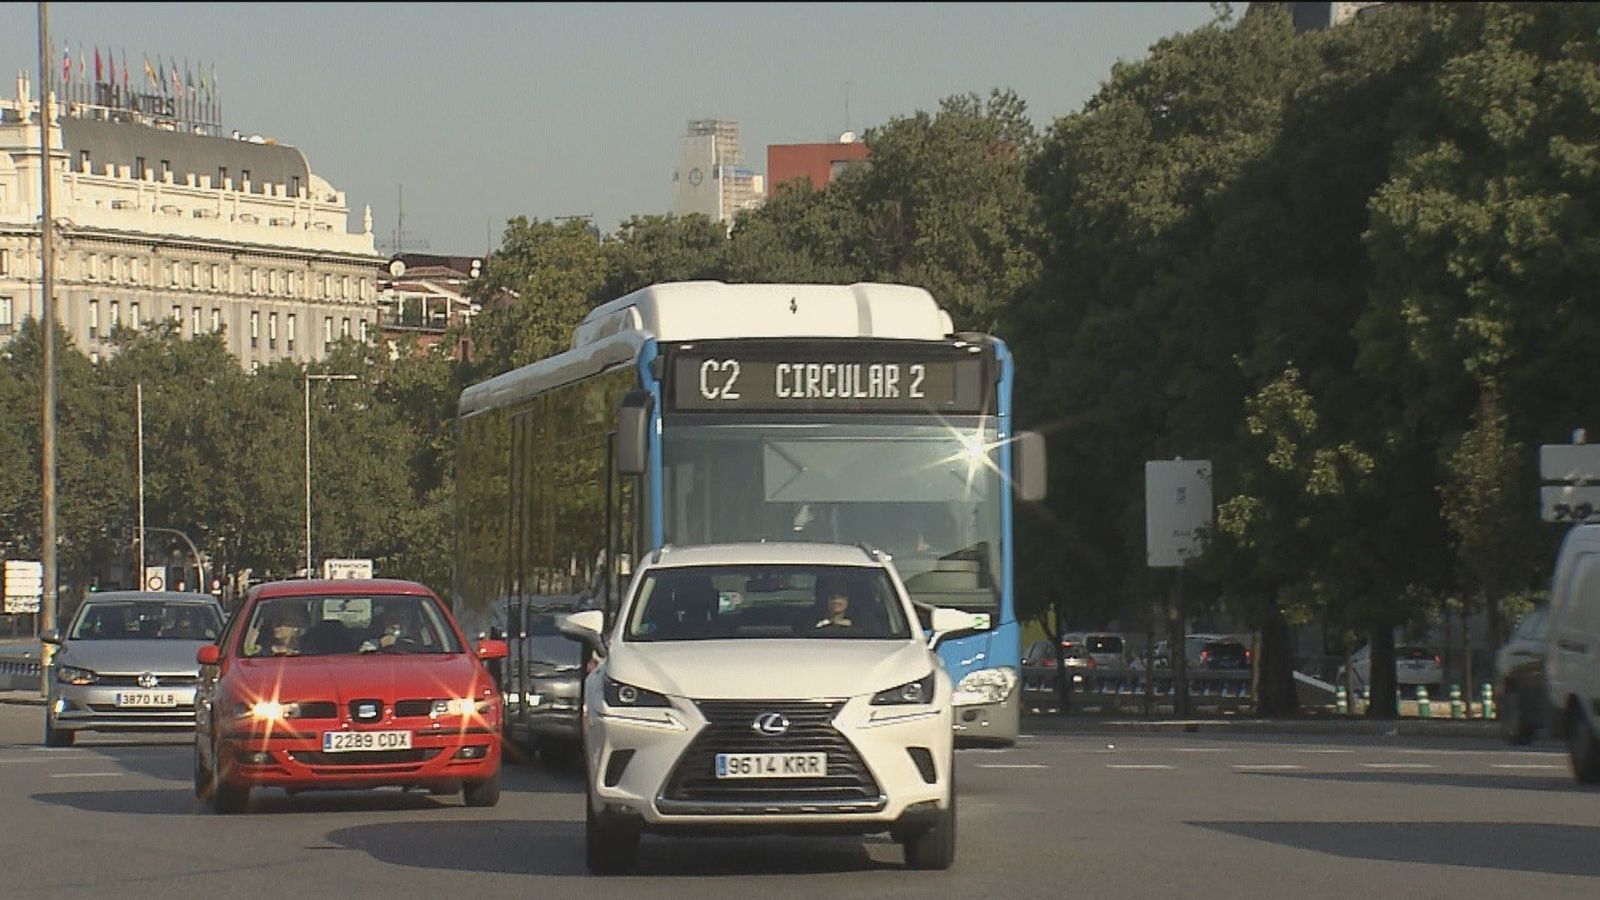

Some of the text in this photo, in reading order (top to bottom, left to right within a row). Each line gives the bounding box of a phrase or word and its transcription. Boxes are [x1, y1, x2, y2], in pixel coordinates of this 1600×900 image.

[699, 358, 926, 400] C2 CIRCULAR 2
[122, 694, 175, 705] 3870 KLR
[334, 732, 408, 750] 2289 CDX
[728, 756, 820, 775] 9614 KRR
